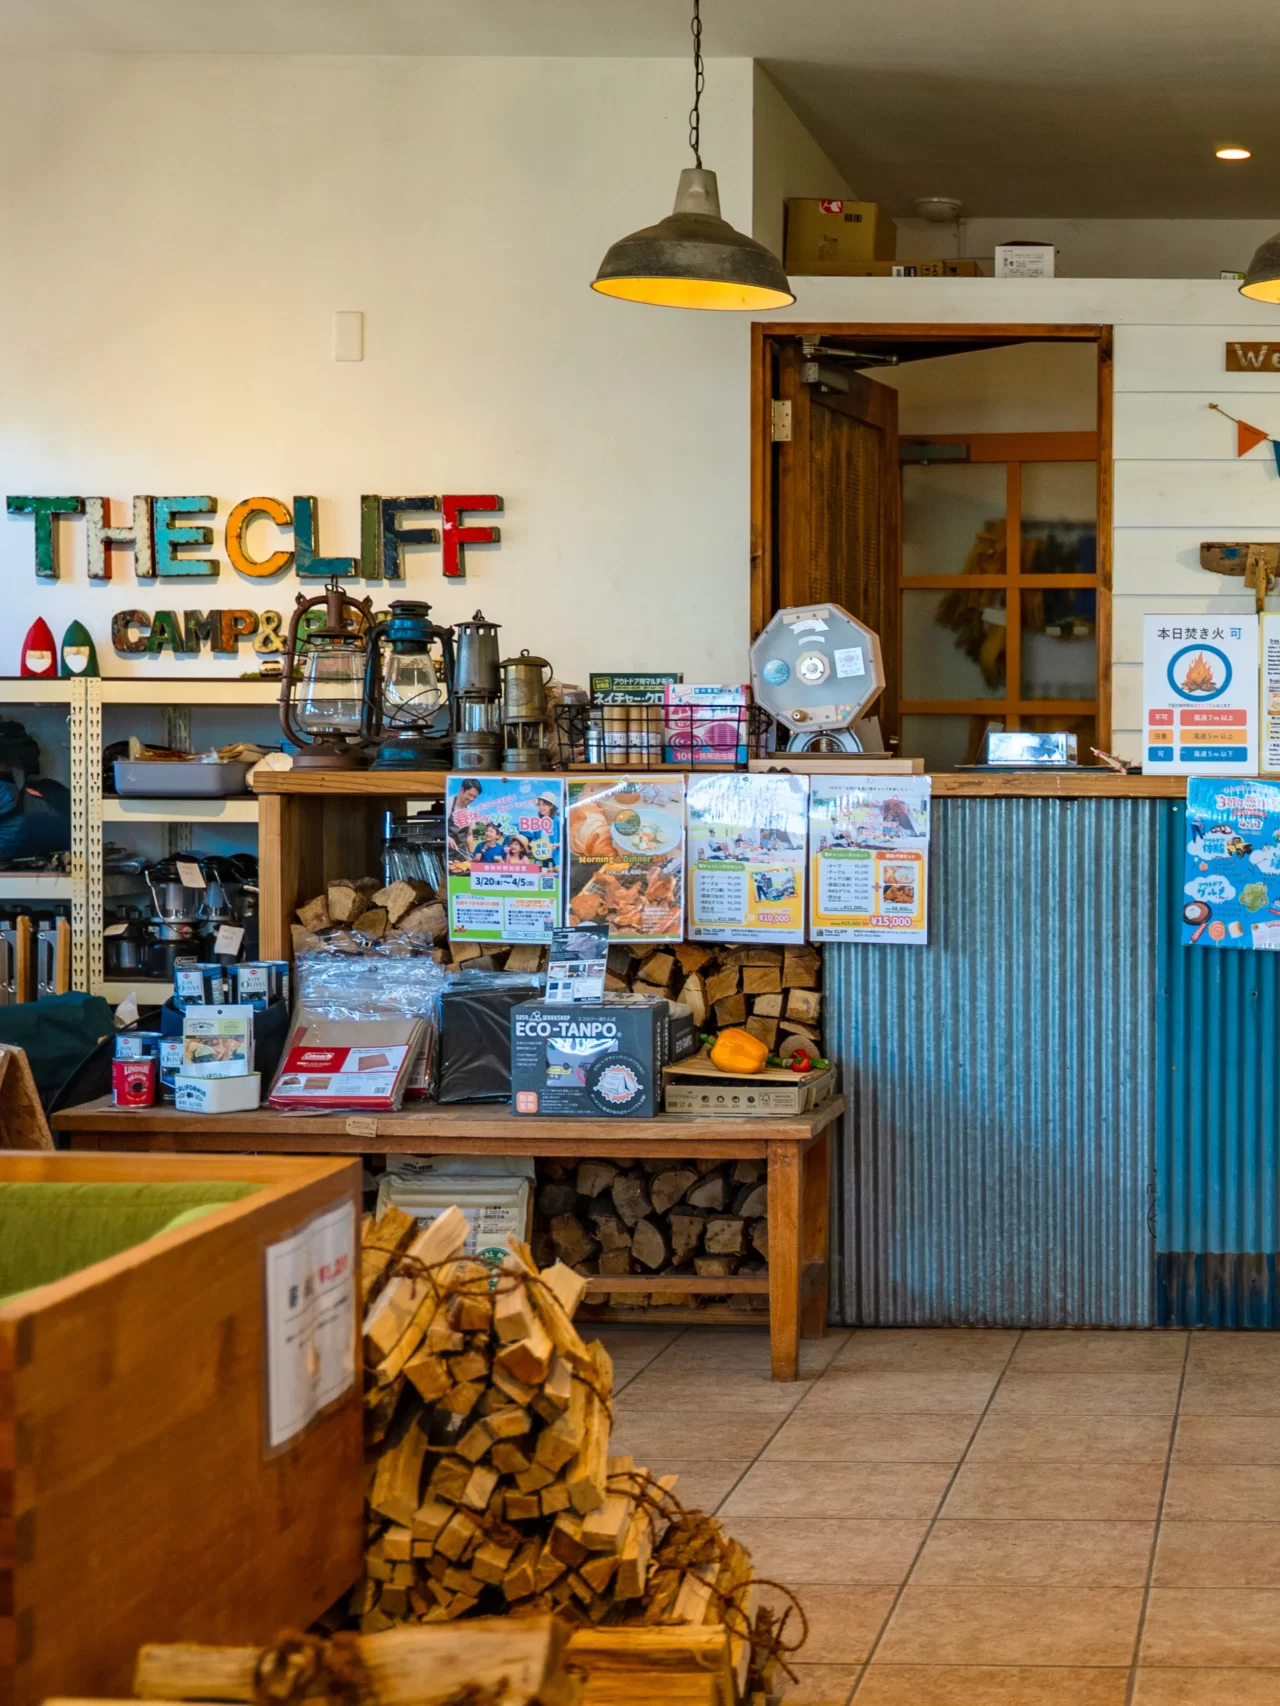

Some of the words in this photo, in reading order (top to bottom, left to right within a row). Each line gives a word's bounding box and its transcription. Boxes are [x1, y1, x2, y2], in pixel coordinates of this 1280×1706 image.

[1157, 627, 1225, 640] 本日焚き火
[1229, 627, 1242, 640] 可
[520, 817, 553, 834] BBQ
[579, 855, 614, 864] Morning
[622, 855, 652, 863] Dinner
[758, 913, 790, 922] ¥10,000
[870, 916, 911, 927] ¥15,000
[515, 1021, 617, 1037] ECO-TANPO
[124, 1065, 149, 1075] LINDSAY
